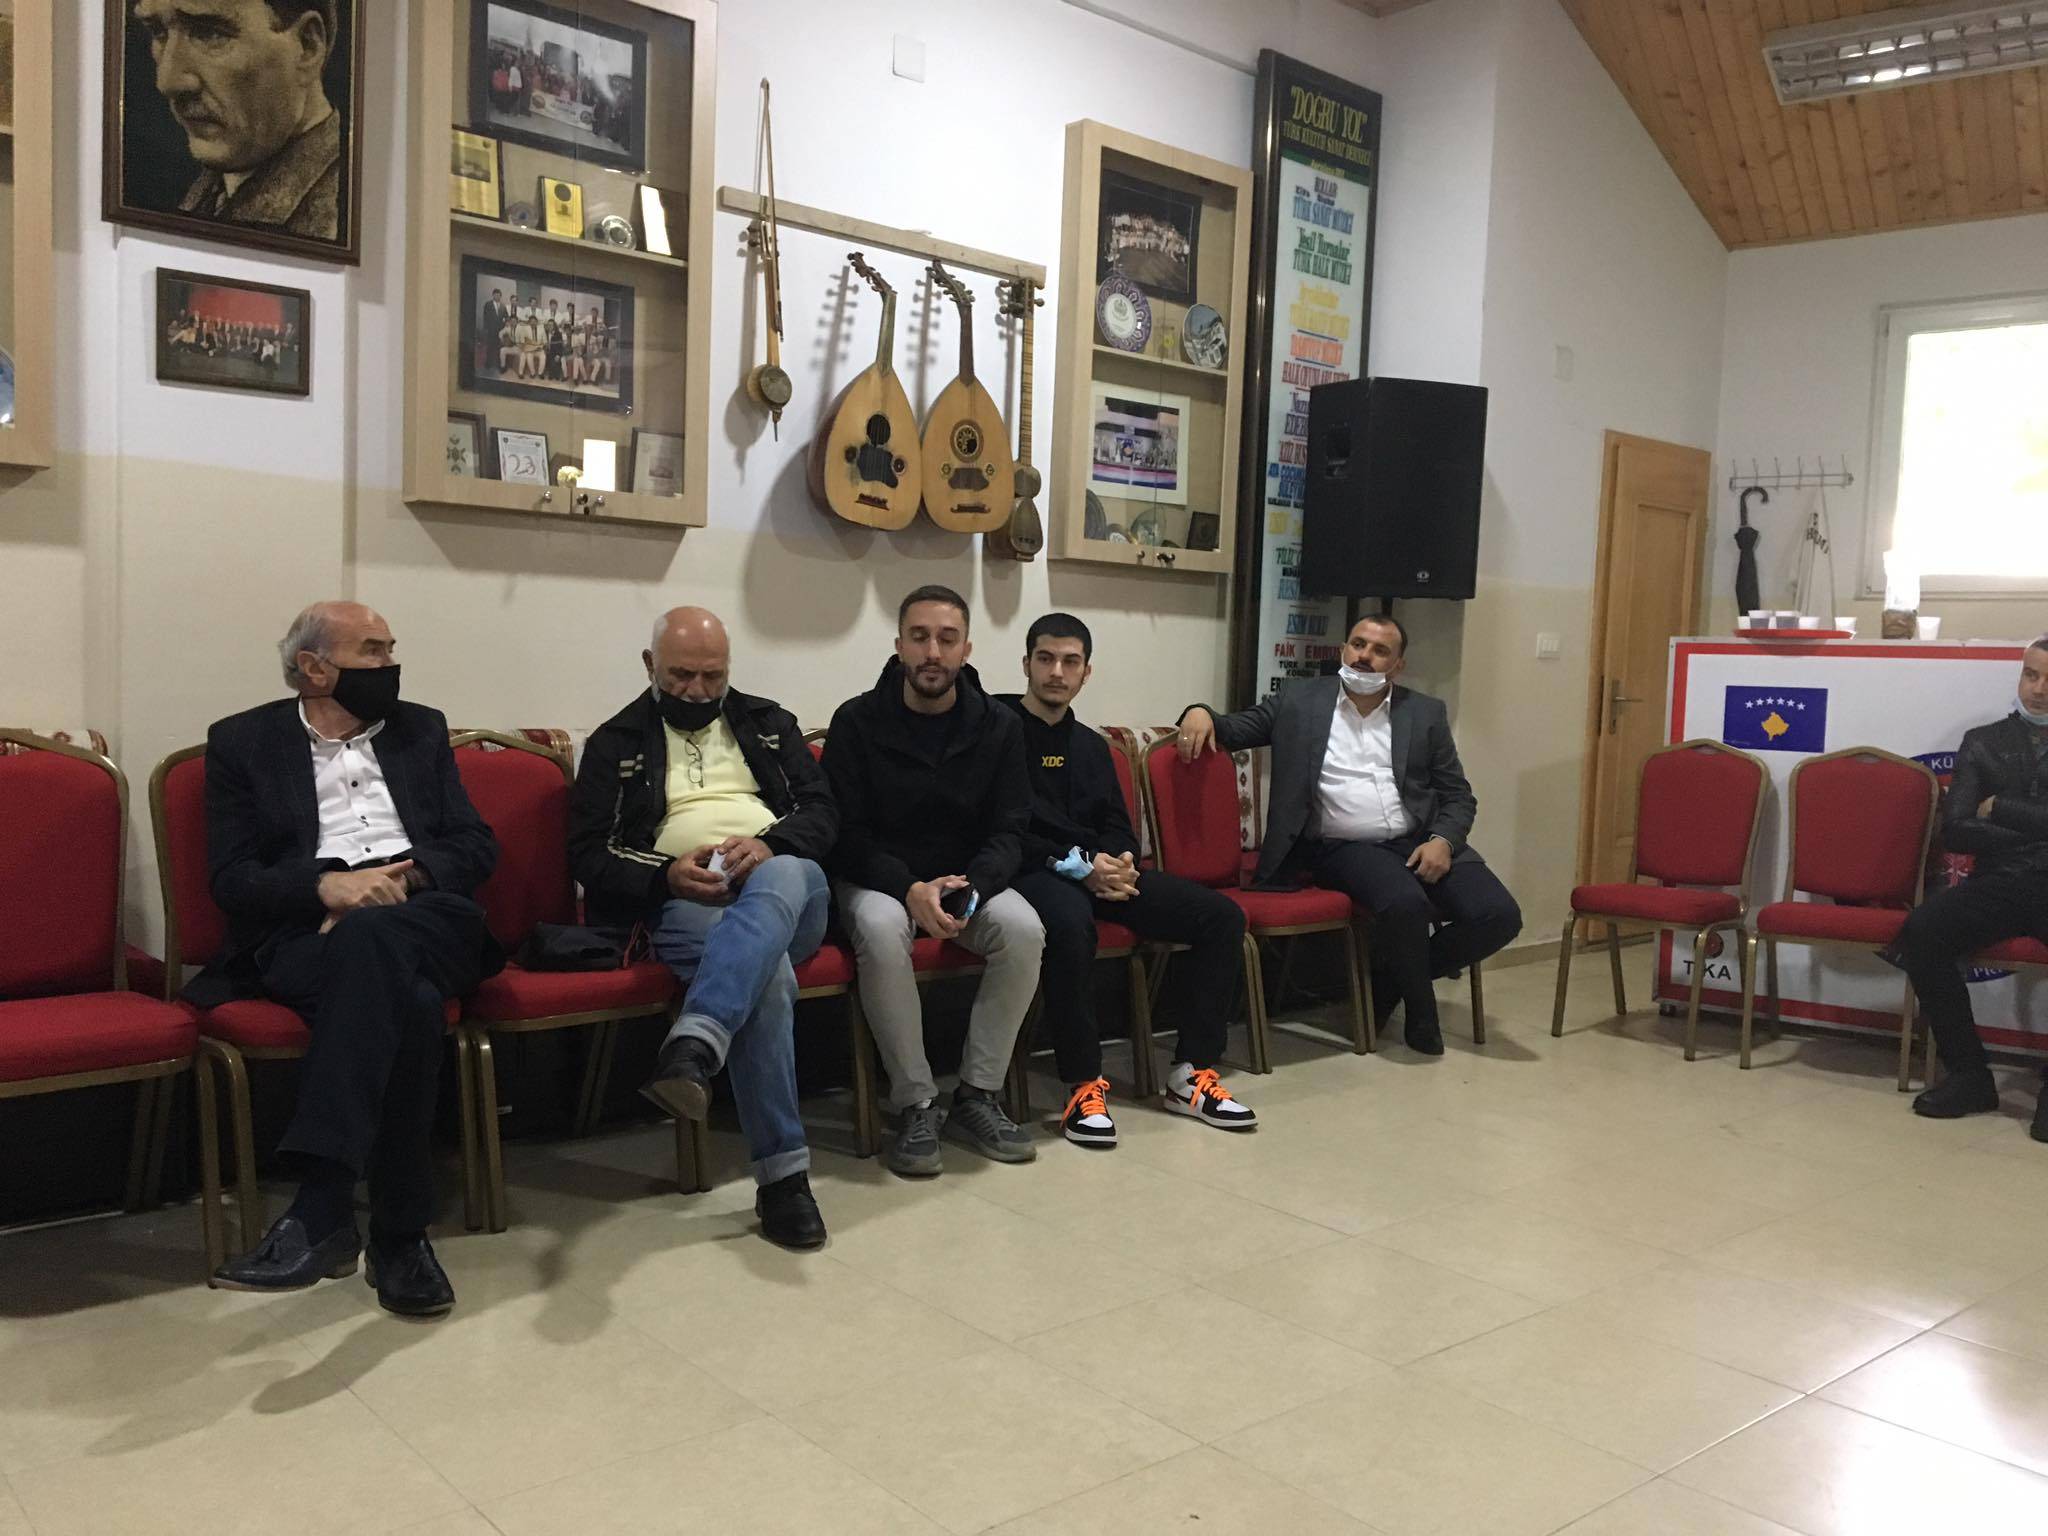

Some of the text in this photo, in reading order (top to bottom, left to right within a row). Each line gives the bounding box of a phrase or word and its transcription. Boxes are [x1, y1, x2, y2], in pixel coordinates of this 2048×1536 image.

[1042, 756, 1064, 767] XDC
[1931, 757, 1954, 769] KÜ
[1683, 960, 1731, 980] TKA
